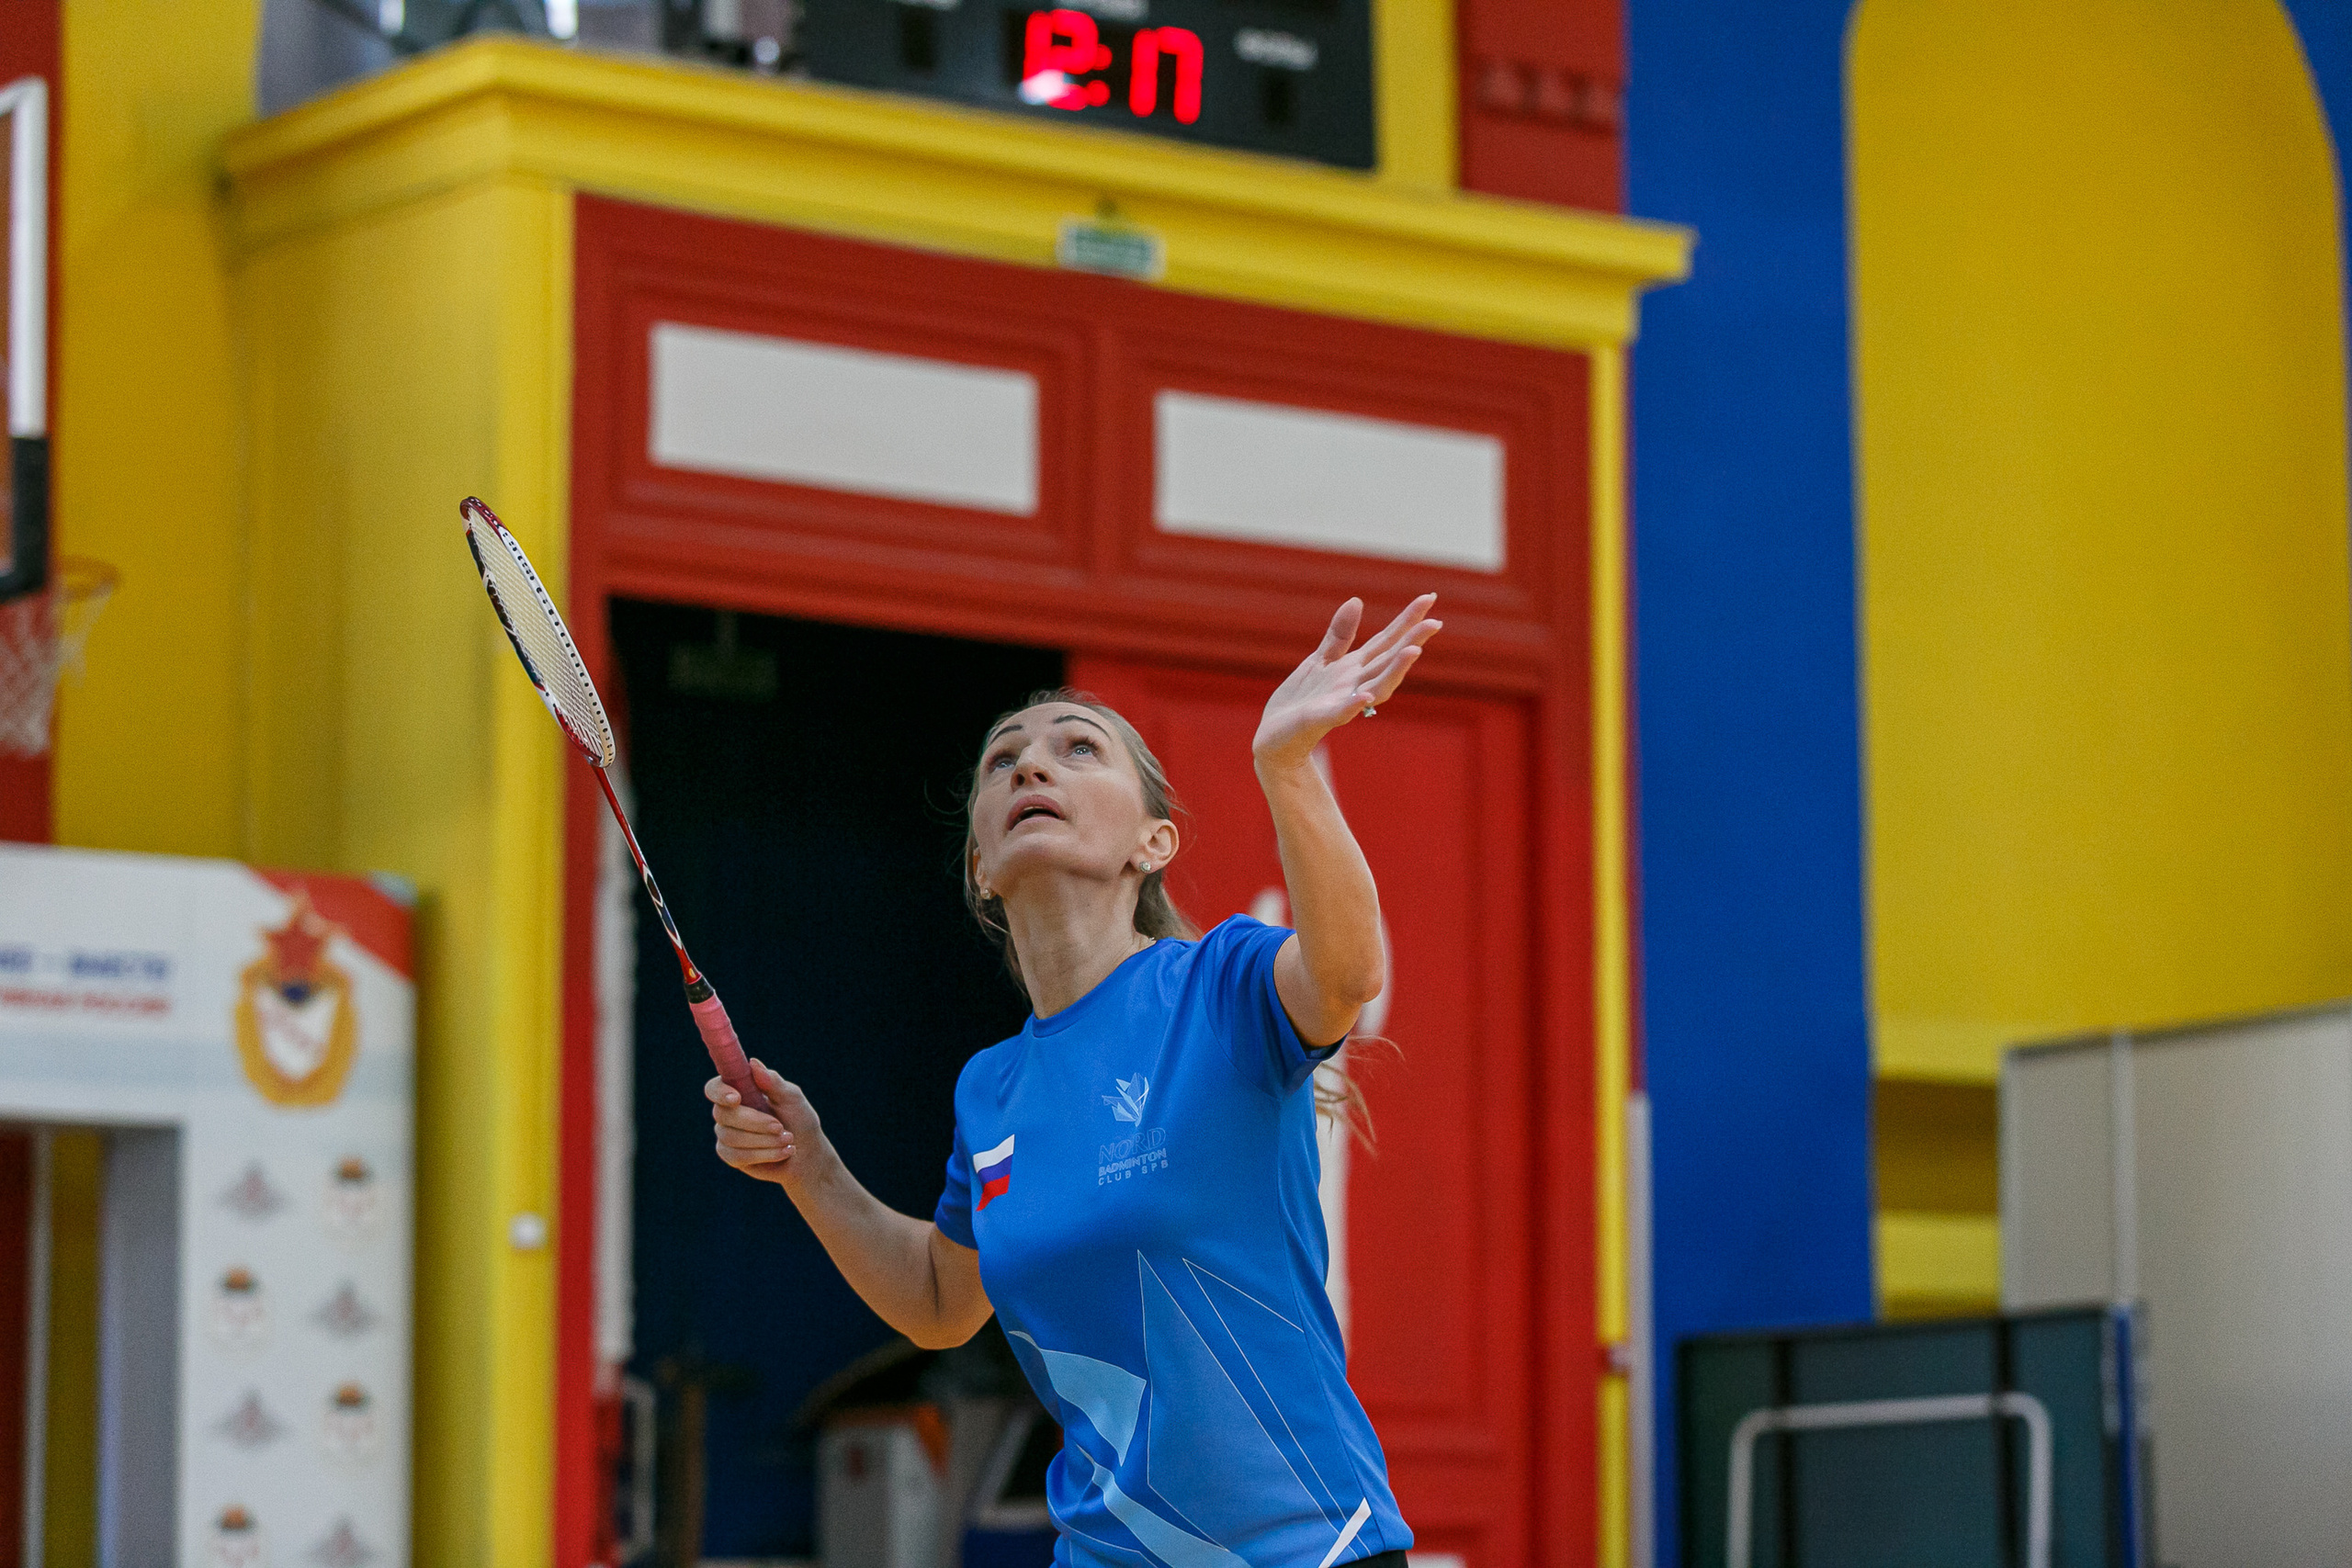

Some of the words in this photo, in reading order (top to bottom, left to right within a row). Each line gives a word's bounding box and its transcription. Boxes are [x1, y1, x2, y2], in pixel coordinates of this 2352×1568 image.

[1099, 1127, 1166, 1164] NORD
[1098, 1147, 1167, 1177] BADMINTON
[1098, 1169, 1131, 1185] CLUB
[1141, 1159, 1169, 1174] SPB
